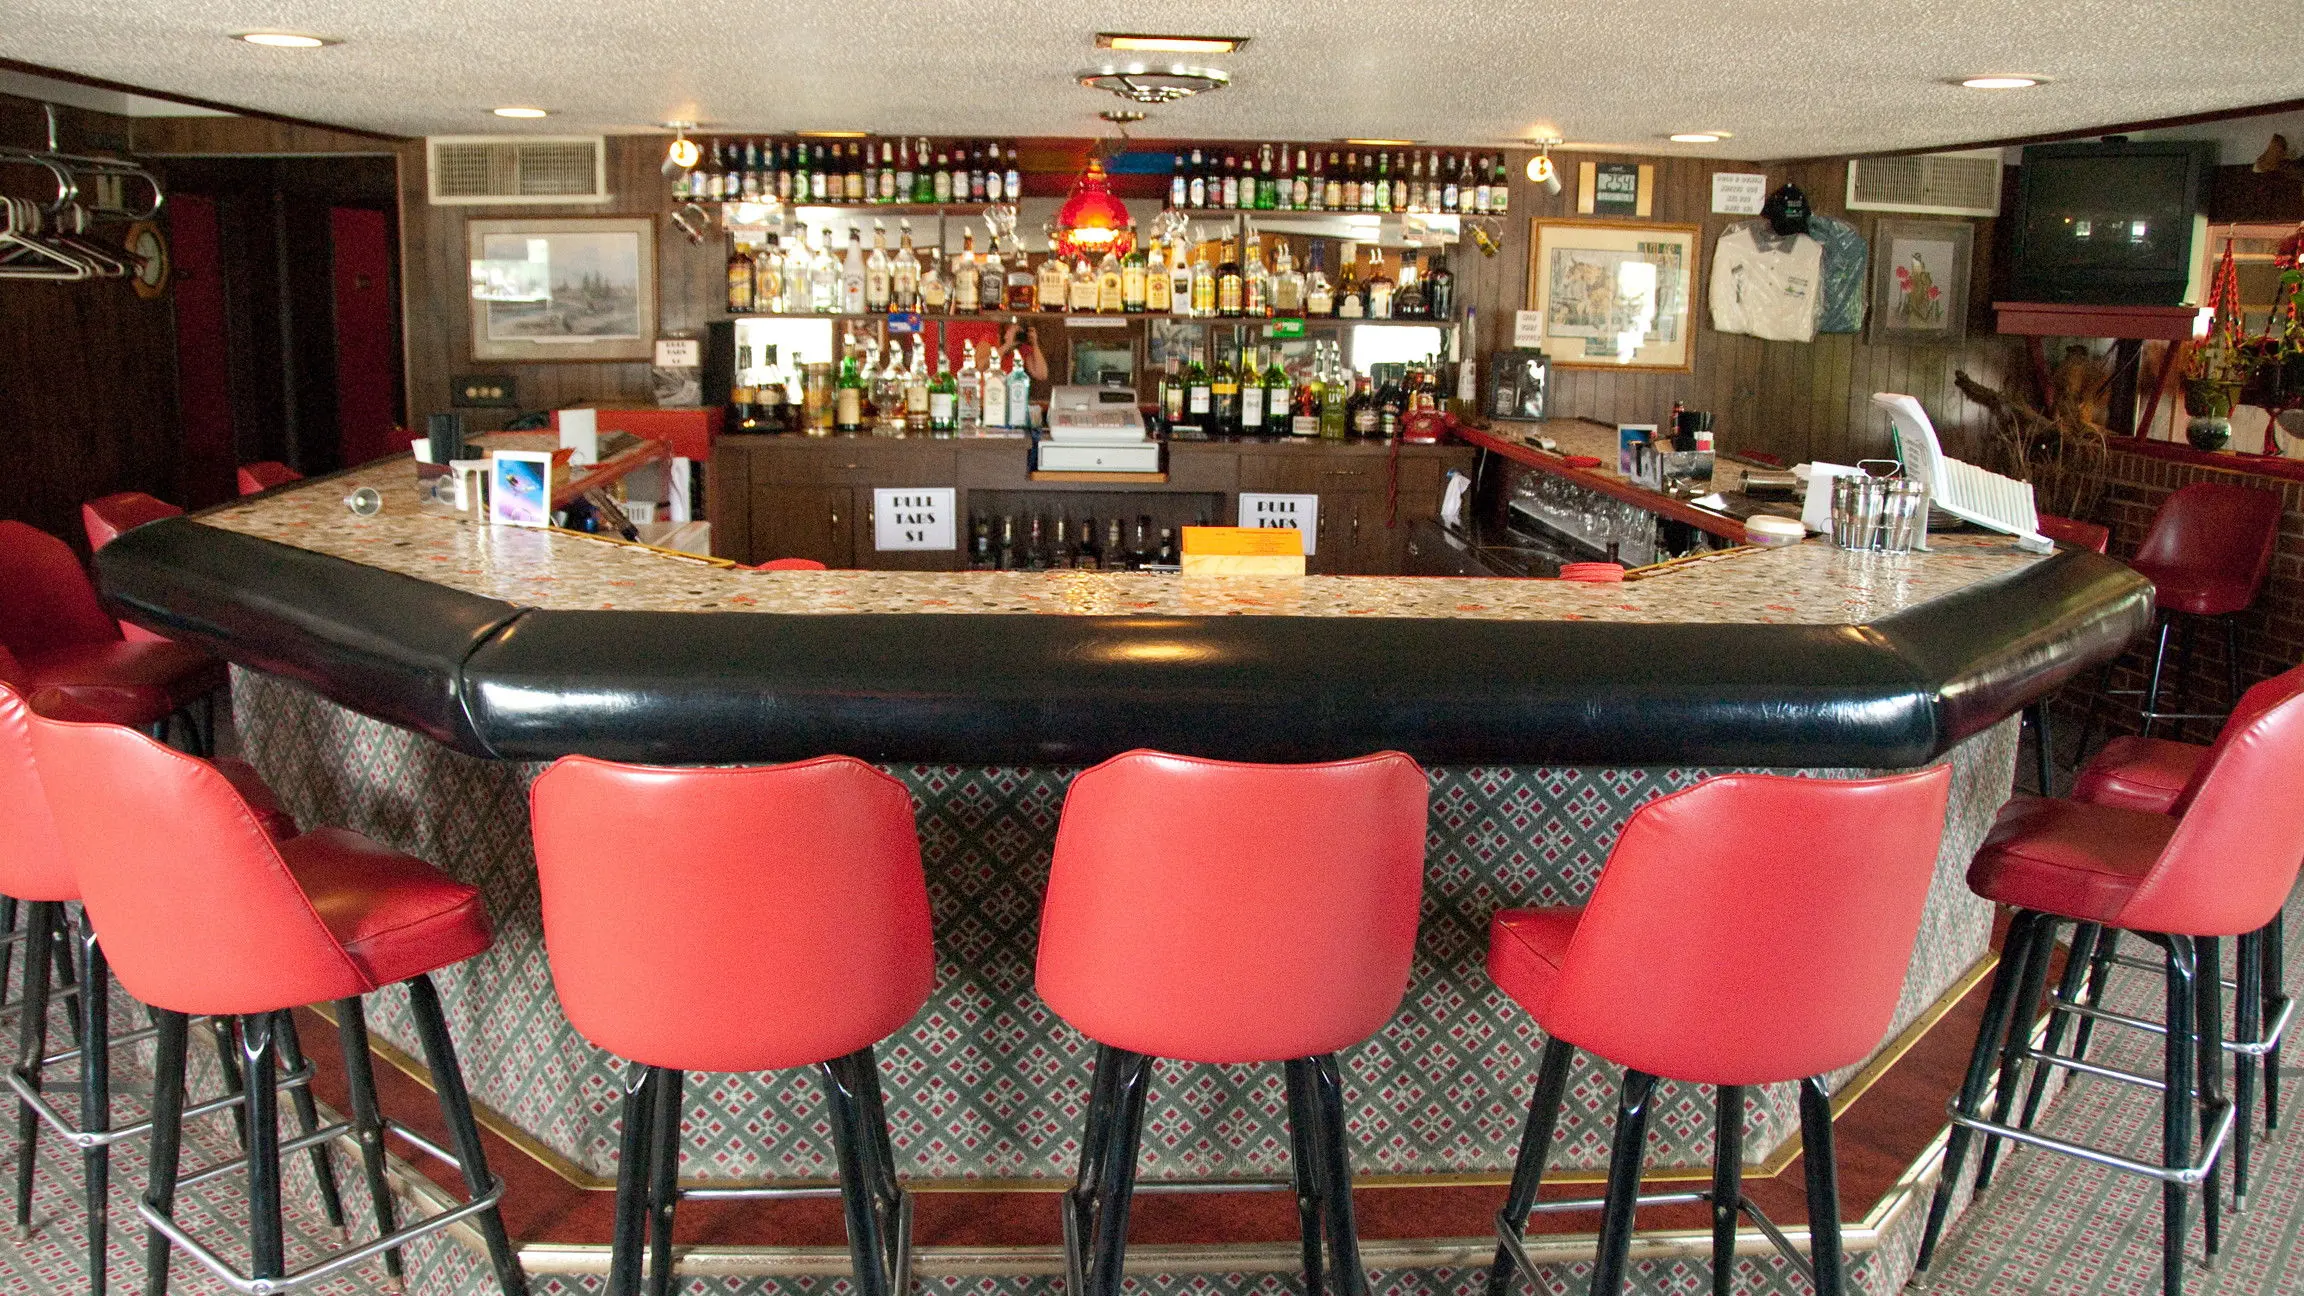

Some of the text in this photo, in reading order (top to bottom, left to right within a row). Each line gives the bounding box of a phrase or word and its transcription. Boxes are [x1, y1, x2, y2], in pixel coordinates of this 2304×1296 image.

[893, 496, 936, 507] PULL
[1257, 501, 1299, 513] PULL
[894, 513, 936, 524] TABS
